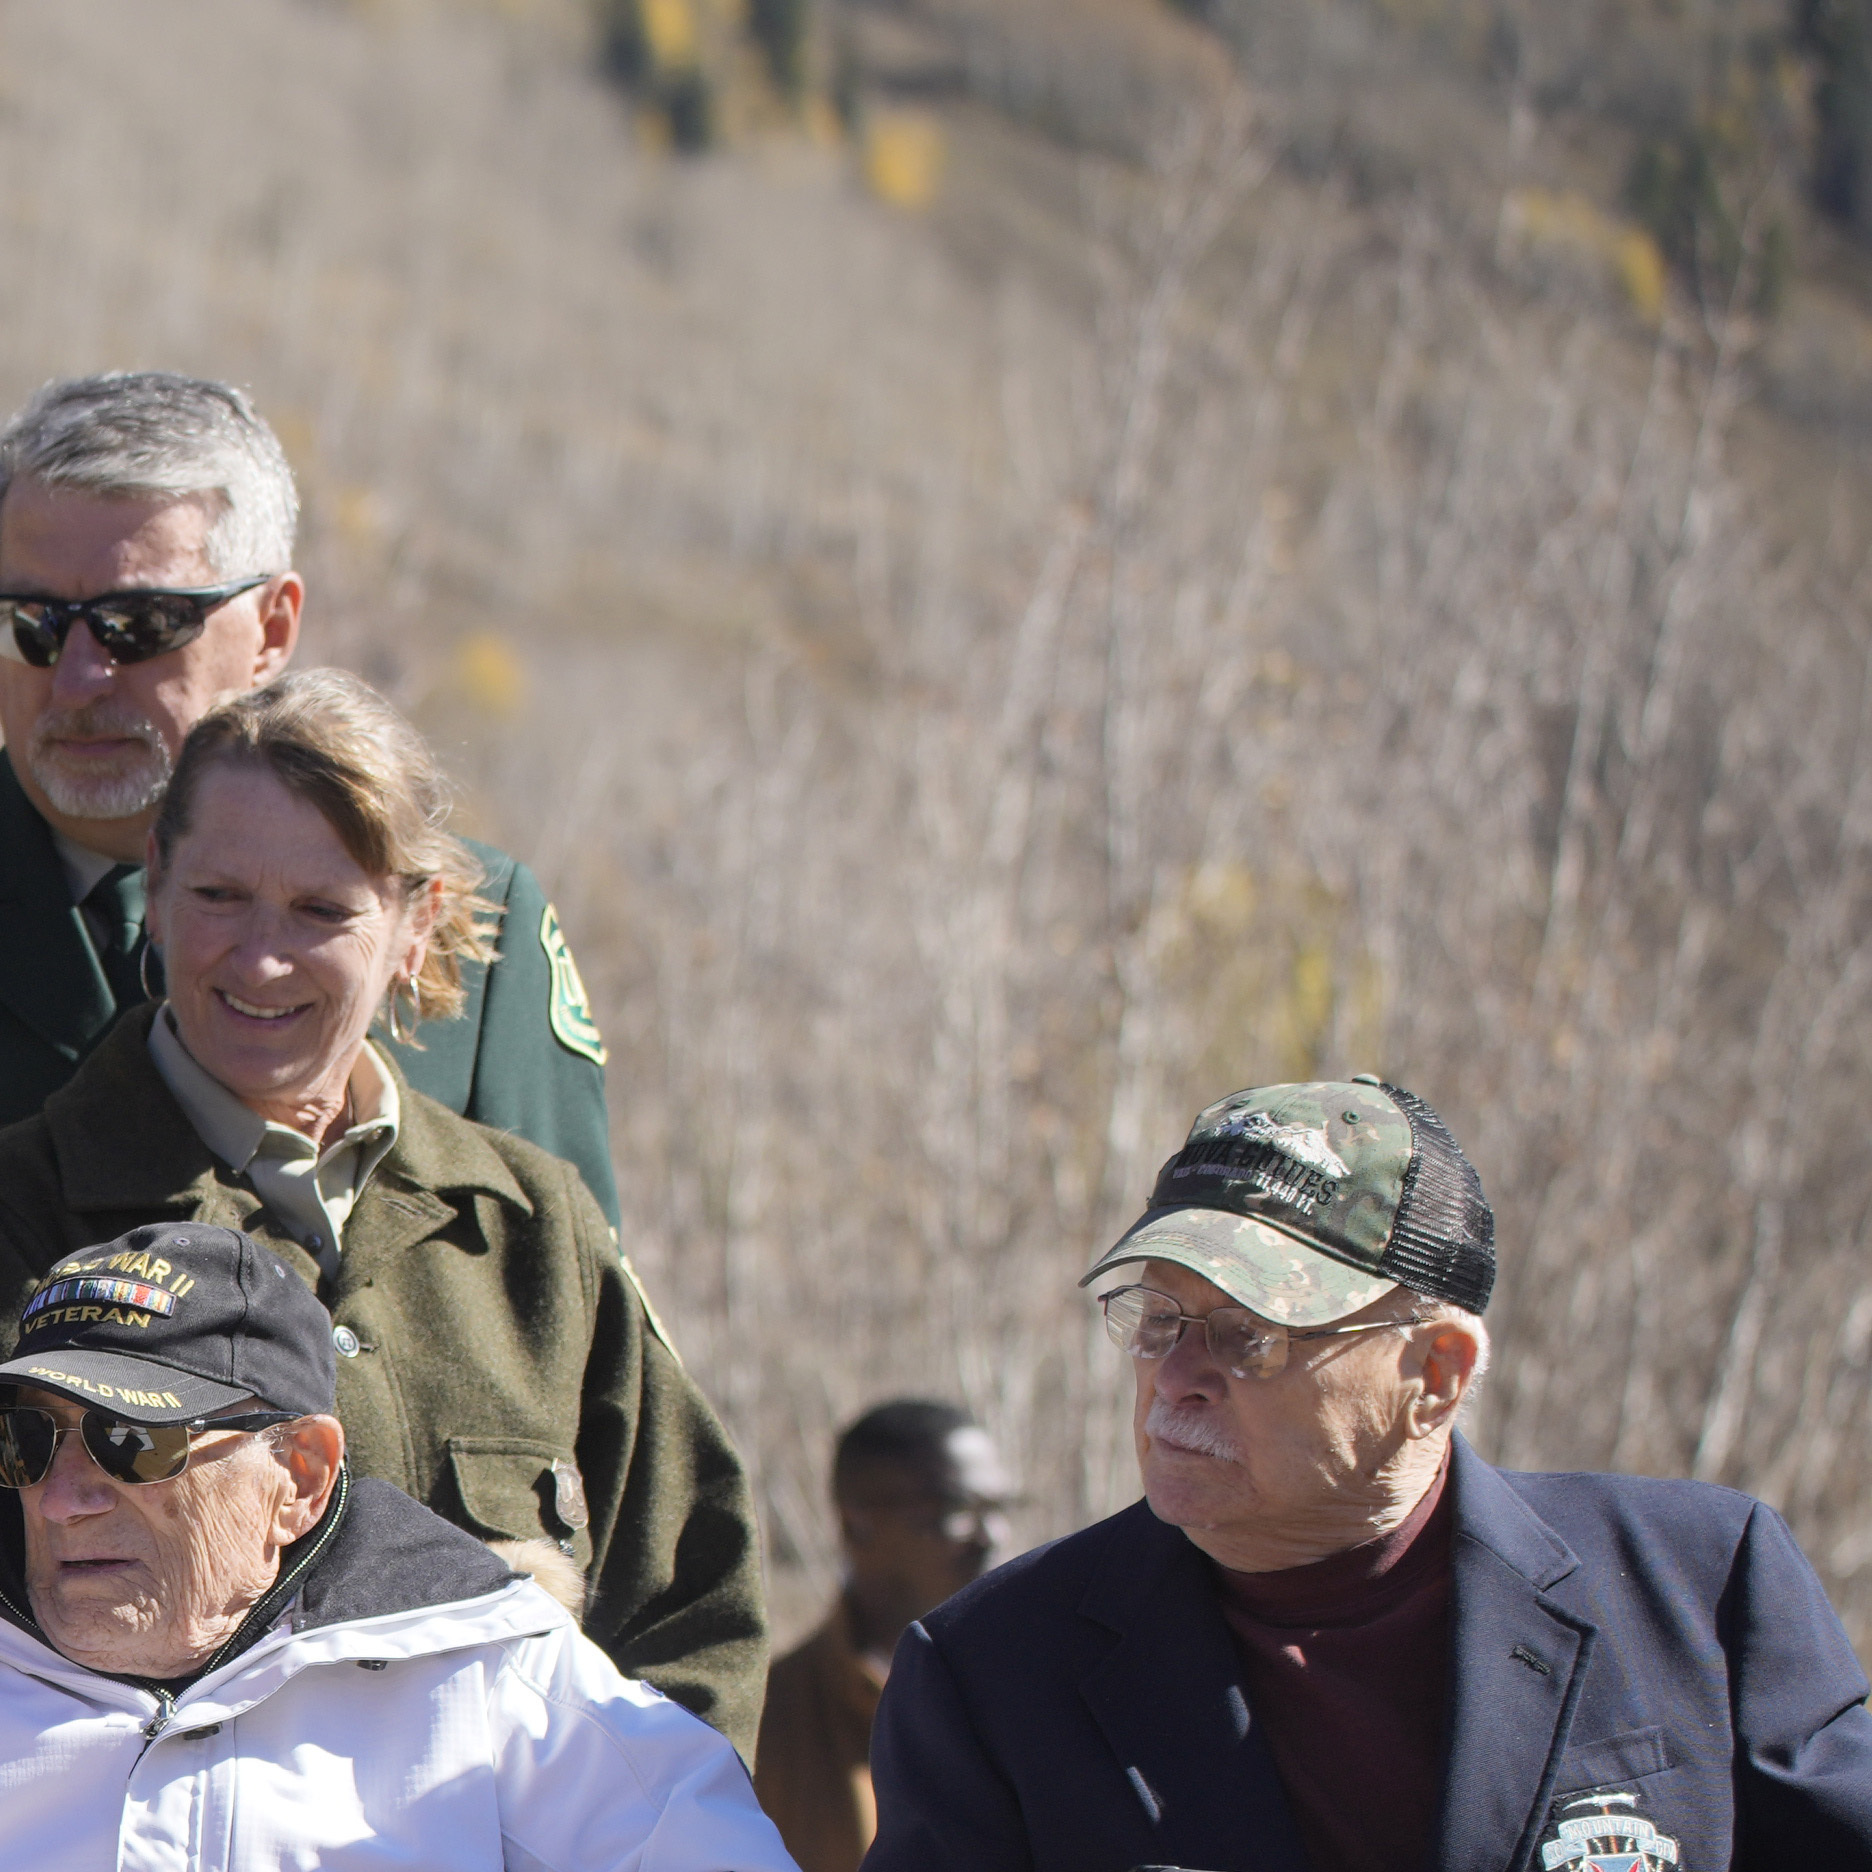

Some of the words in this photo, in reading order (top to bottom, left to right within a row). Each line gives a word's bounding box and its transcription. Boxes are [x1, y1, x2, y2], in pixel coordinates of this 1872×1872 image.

[108, 1251, 172, 1285] WAR
[169, 1273, 195, 1298] II
[25, 1305, 152, 1335] VETERAN
[28, 1366, 114, 1398] WORLD
[116, 1387, 166, 1409] WAR
[162, 1391, 183, 1409] II
[1567, 1819, 1650, 1841] MOUNTAIN
